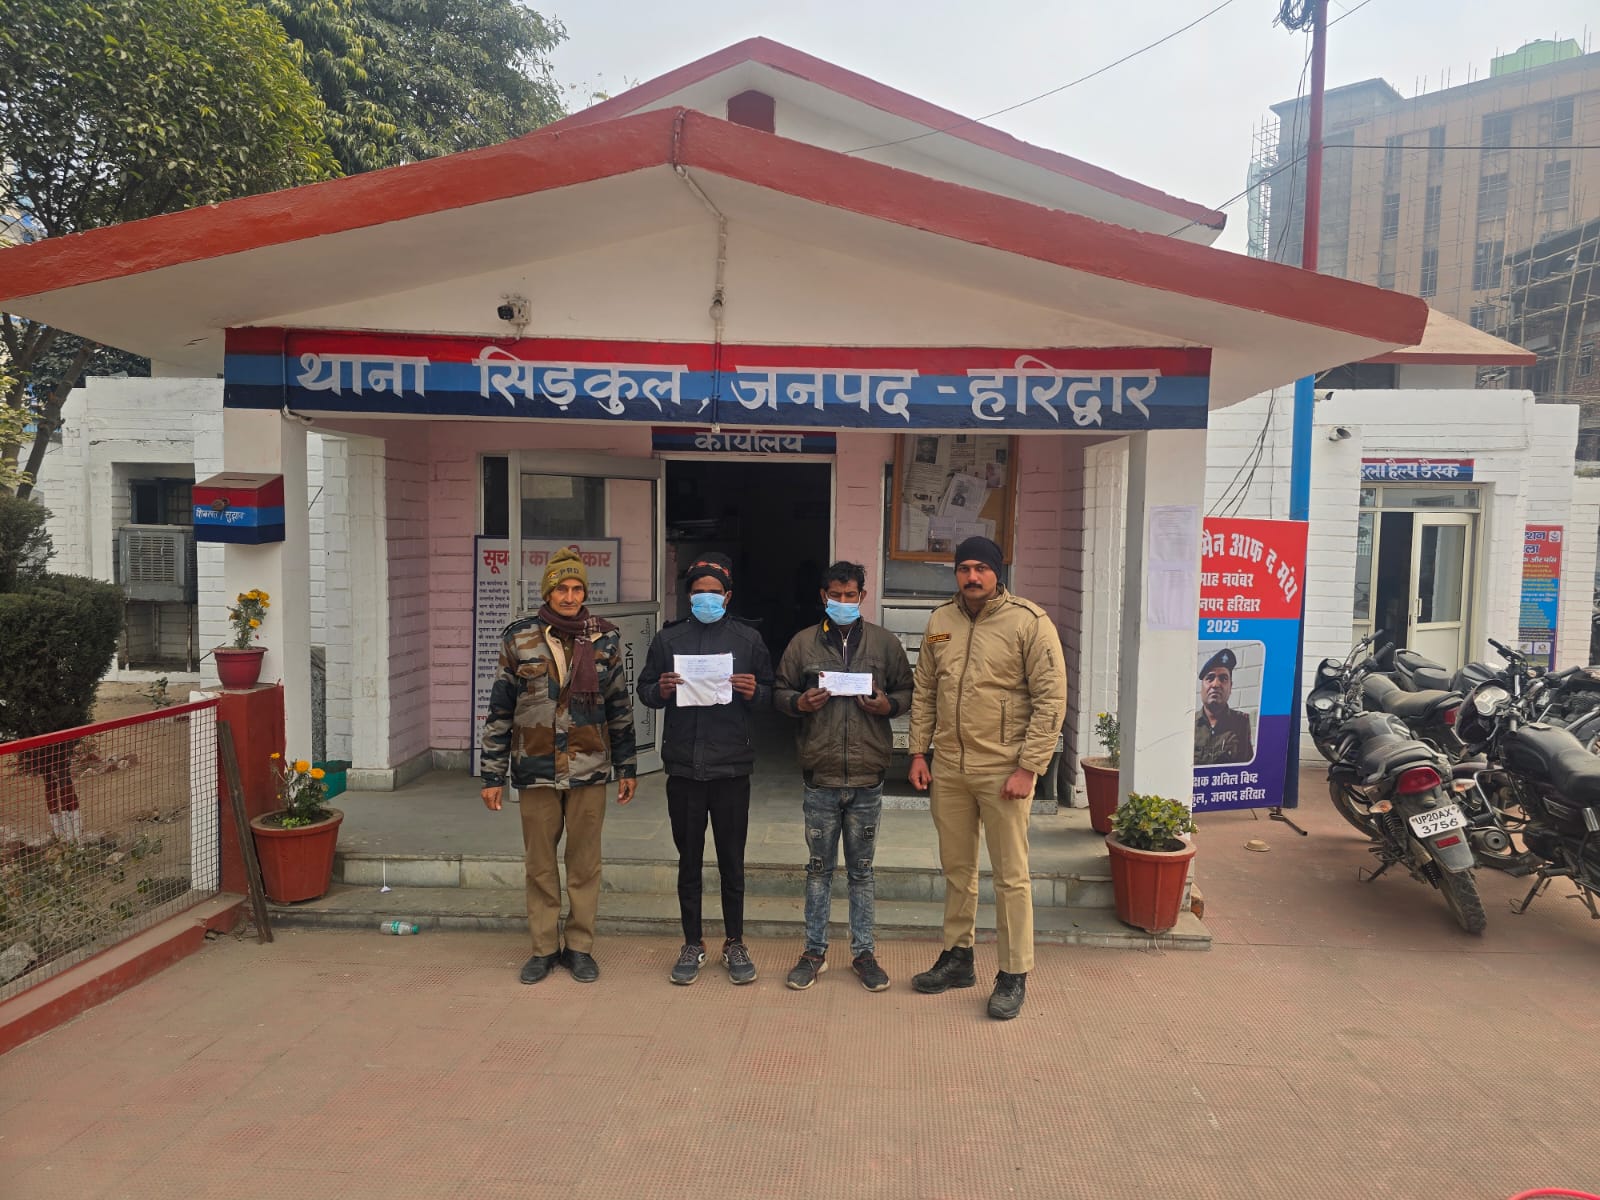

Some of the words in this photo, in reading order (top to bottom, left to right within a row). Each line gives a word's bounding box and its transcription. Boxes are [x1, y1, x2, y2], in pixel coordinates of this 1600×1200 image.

[295, 352, 431, 399] थाना
[731, 364, 920, 423] जनपद
[965, 354, 1163, 427] हरिद्वार
[1206, 619, 1239, 633] 2025
[1415, 808, 1454, 825] UP20AX
[1421, 817, 1459, 835] 3756
